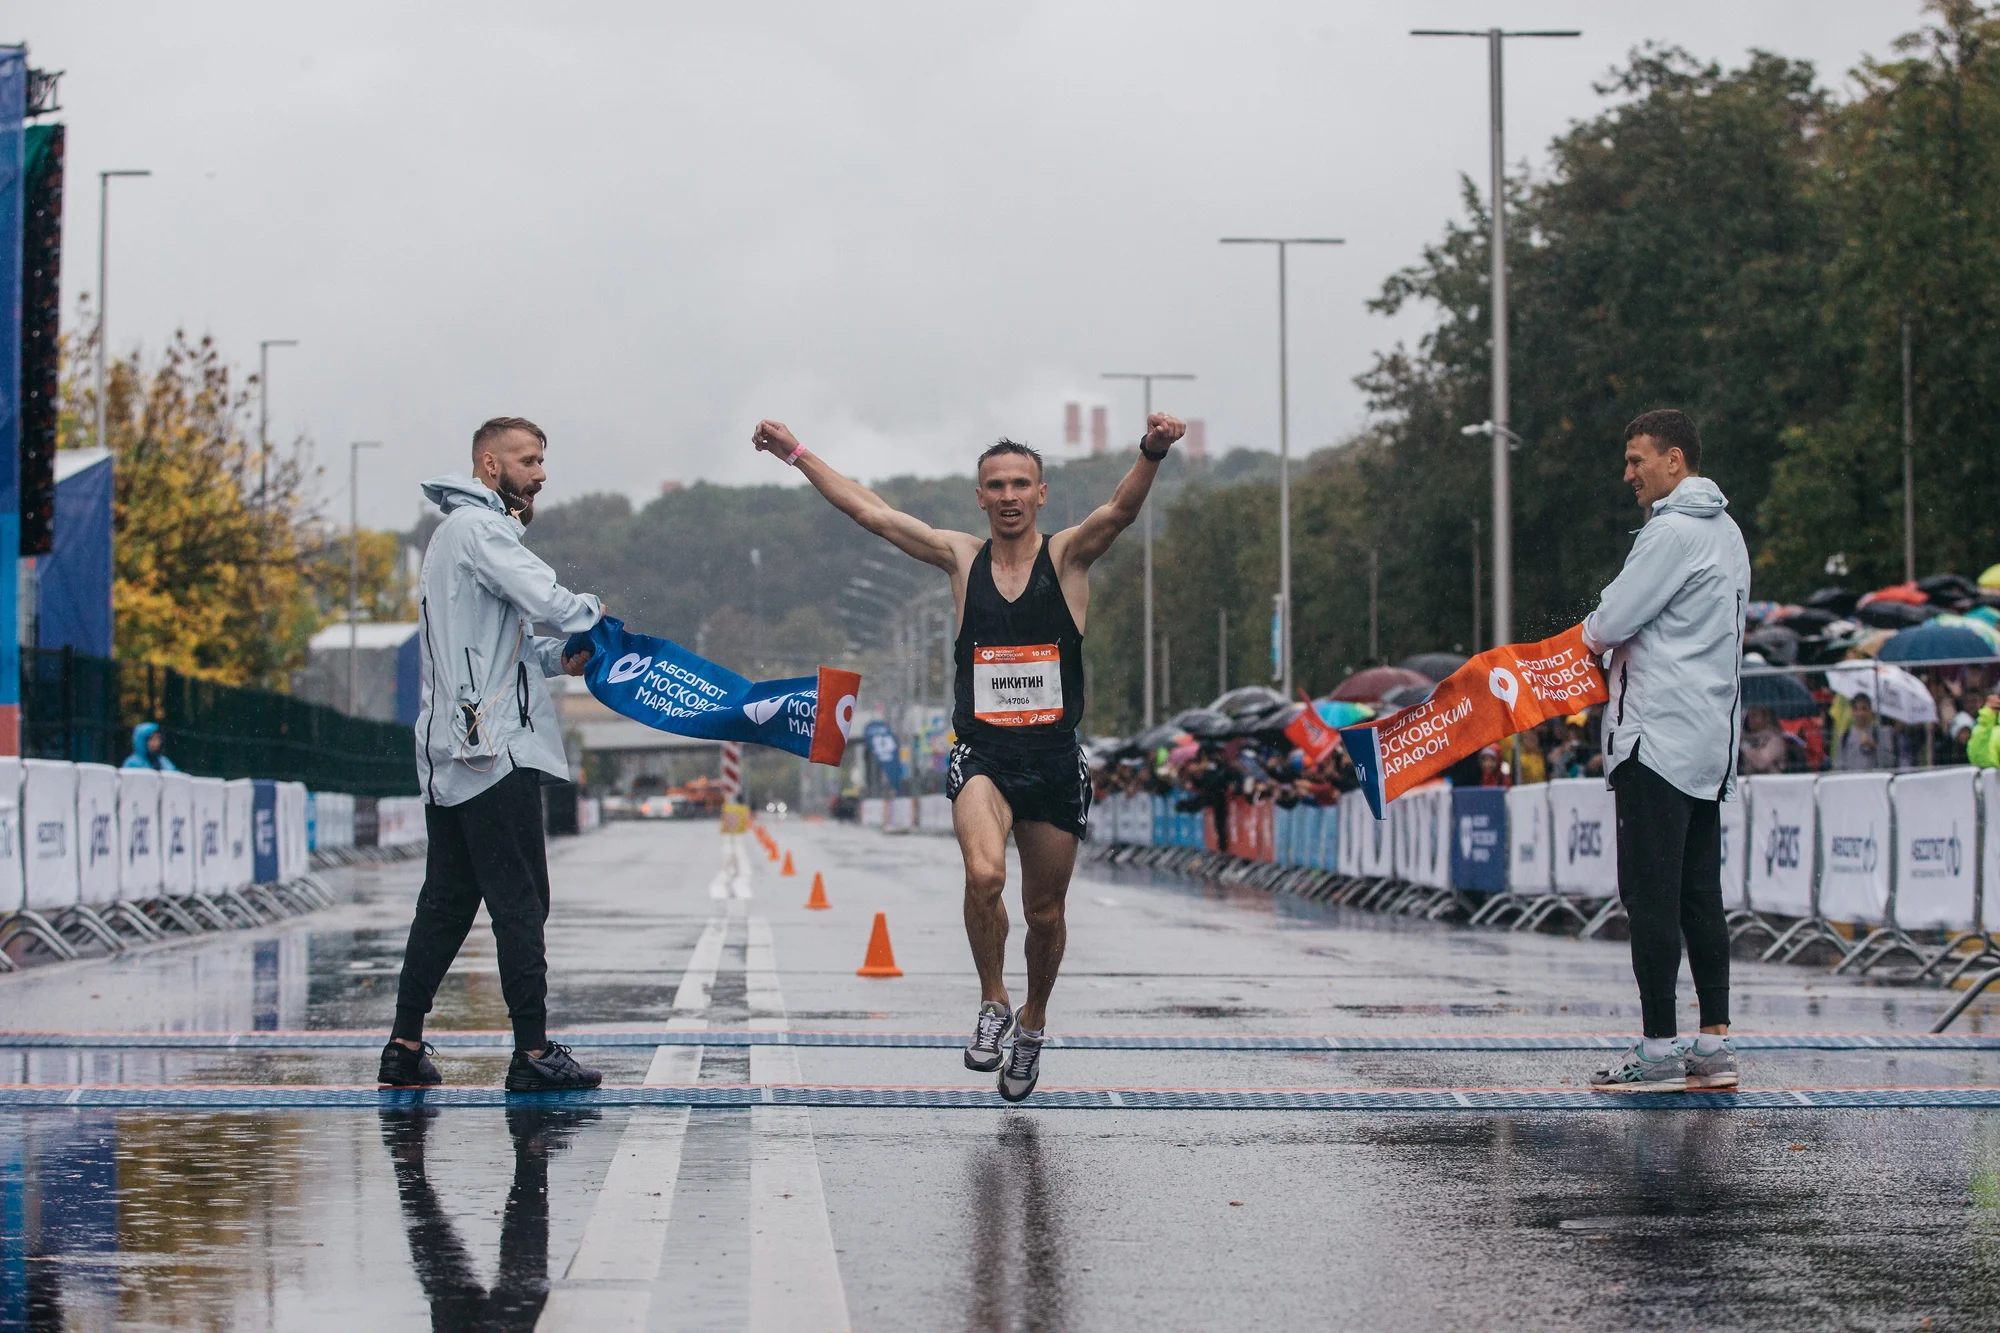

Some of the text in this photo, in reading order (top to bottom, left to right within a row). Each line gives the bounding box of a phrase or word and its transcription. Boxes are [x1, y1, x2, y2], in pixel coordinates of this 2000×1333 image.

[1515, 648, 1573, 670] АСОЛЮТ
[1521, 654, 1596, 687] МСКОВСК
[655, 660, 728, 700] АБСОЛЮТ
[991, 675, 1044, 690] НИКИТИН
[635, 686, 703, 718] МАРАФОН
[1037, 714, 1056, 722] asics
[1384, 732, 1450, 780] АРАФОН
